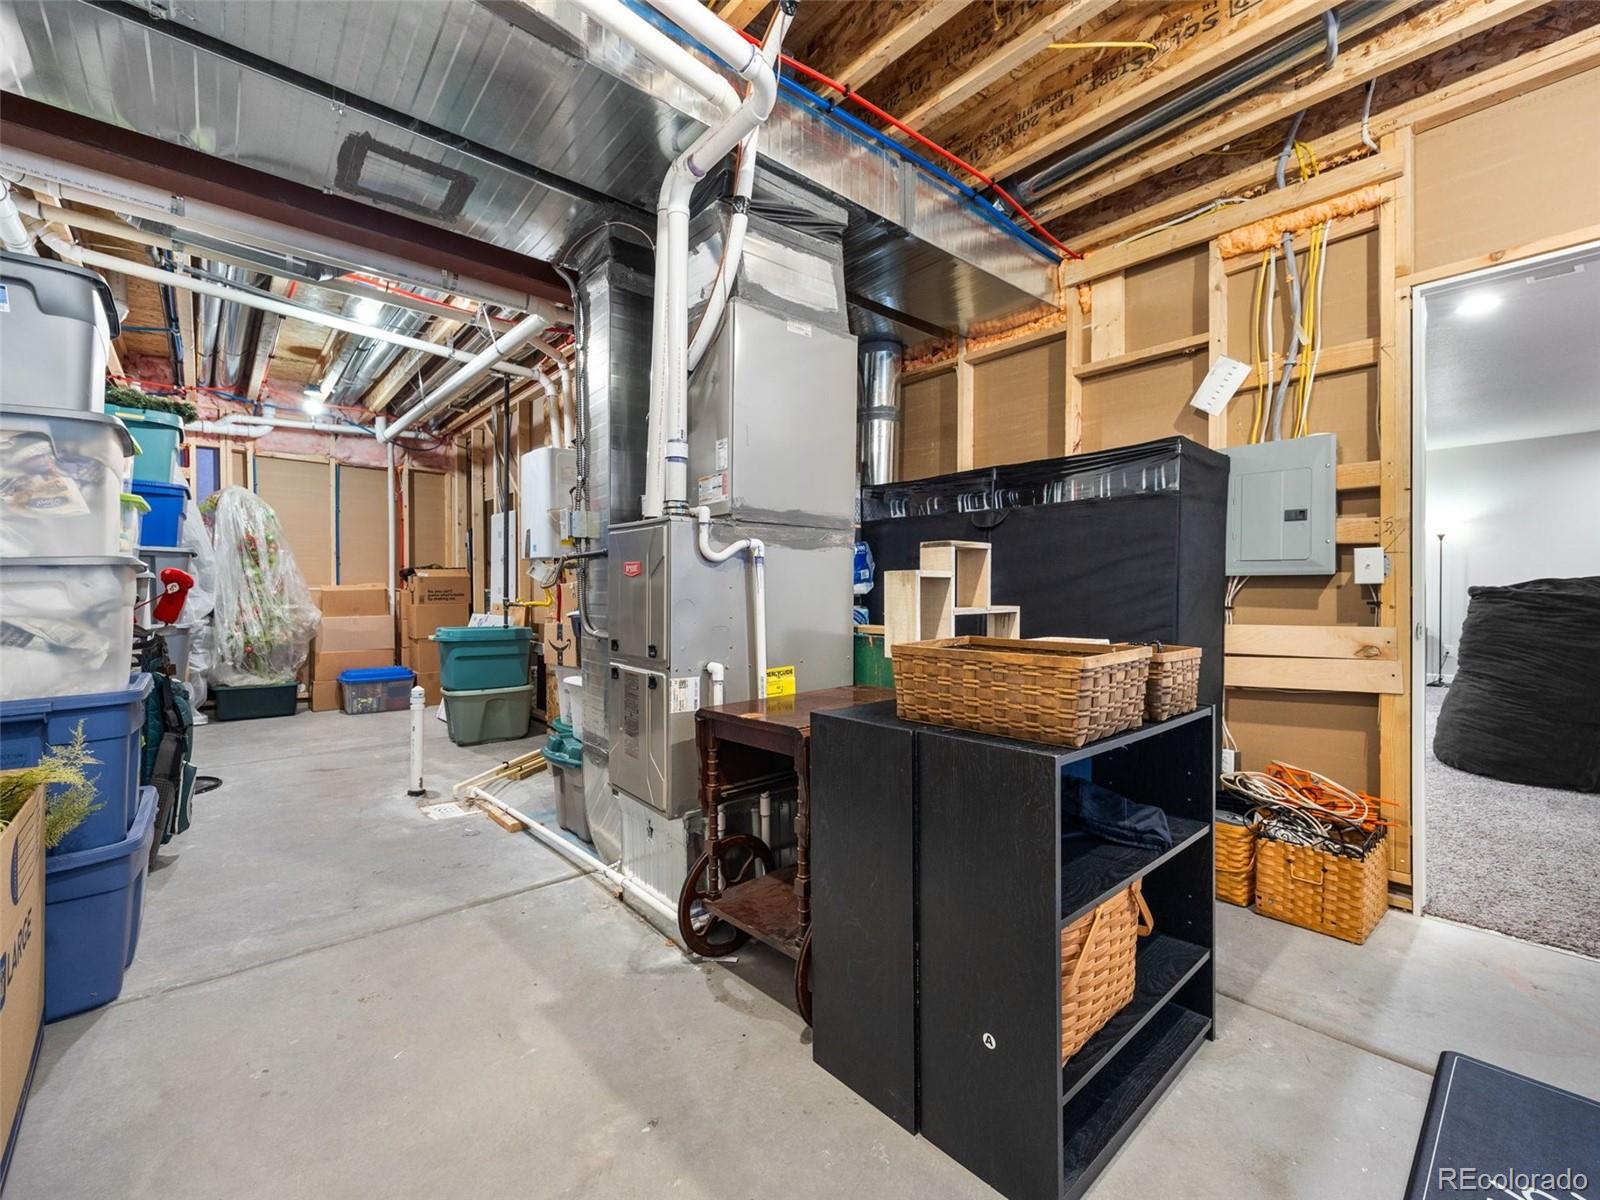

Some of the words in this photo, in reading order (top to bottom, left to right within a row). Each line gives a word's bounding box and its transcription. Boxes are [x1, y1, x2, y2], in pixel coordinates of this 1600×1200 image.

[1016, 88, 1064, 122] RESOLUTE
[1049, 94, 1074, 117] LPI
[7, 906, 32, 986] LARGE
[985, 1035, 994, 1047] A
